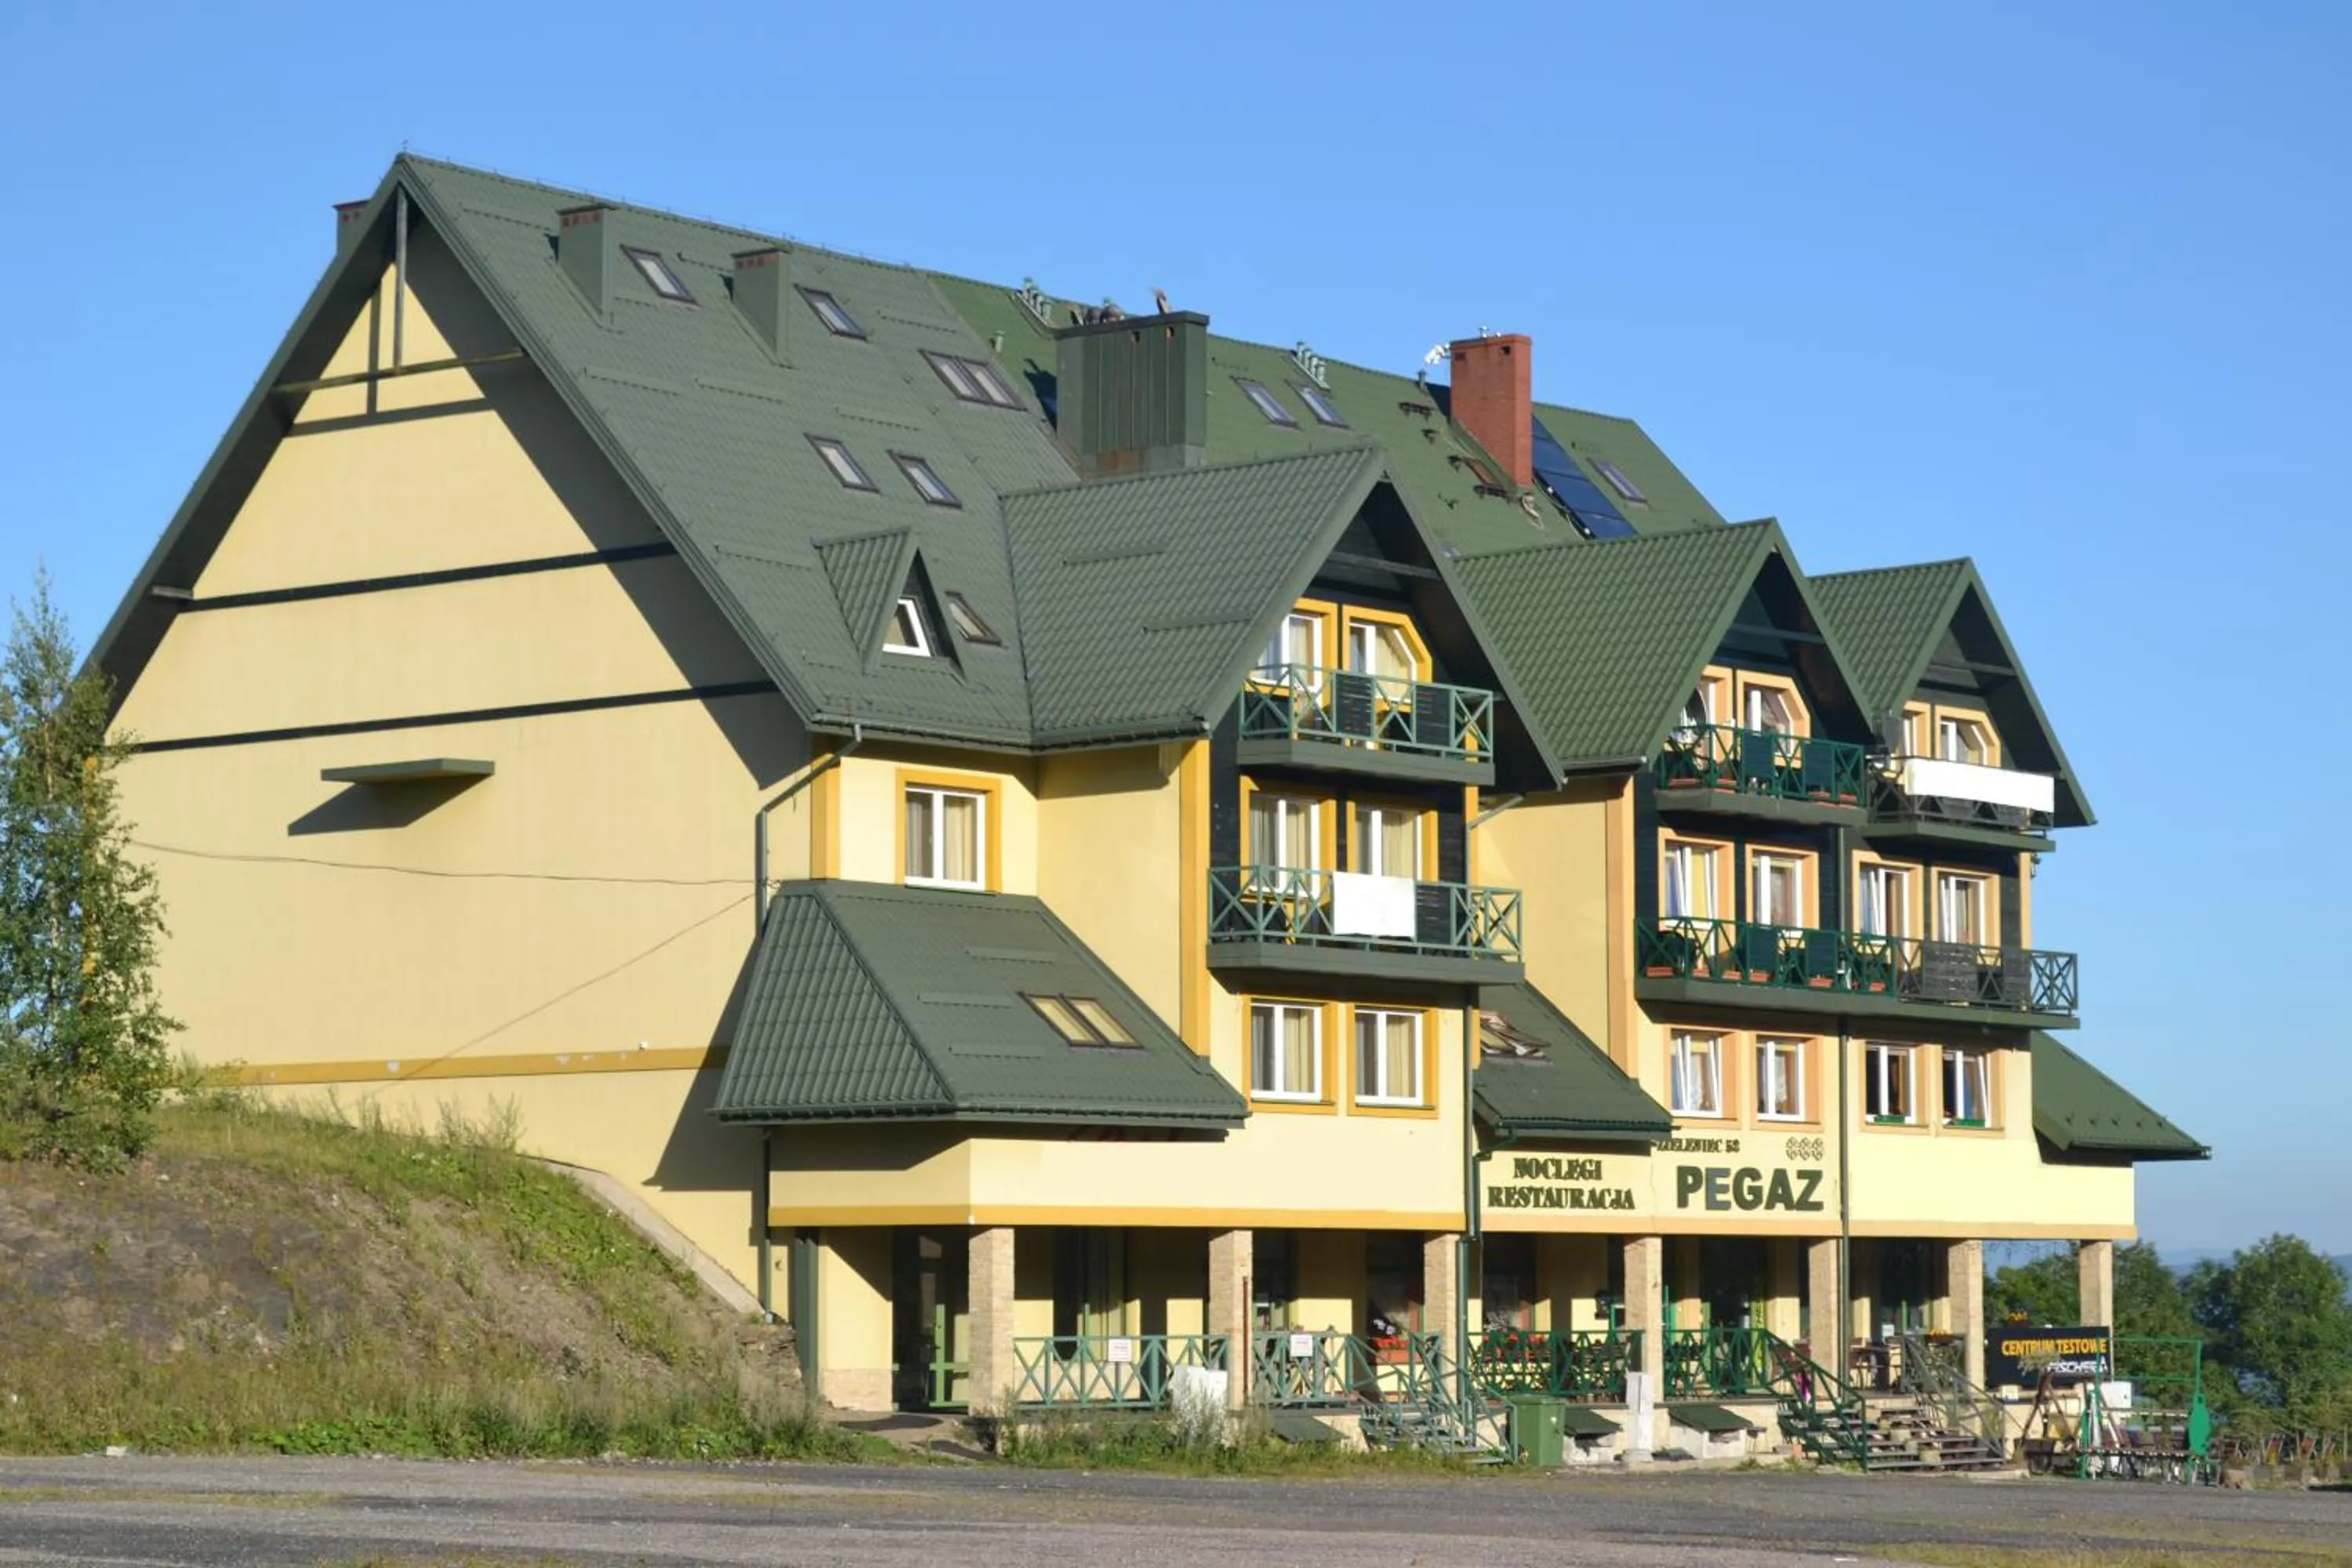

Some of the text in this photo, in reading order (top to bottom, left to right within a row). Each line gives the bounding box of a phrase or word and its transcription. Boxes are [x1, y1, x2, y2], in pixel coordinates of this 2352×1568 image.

[1513, 1157, 1602, 1181] NOCLEGI
[1487, 1185, 1636, 1210] RESTAURACJA
[1676, 1165, 1824, 1211] PEGAZ
[2002, 1338, 2107, 1356] CENTRUM TESTOWE
